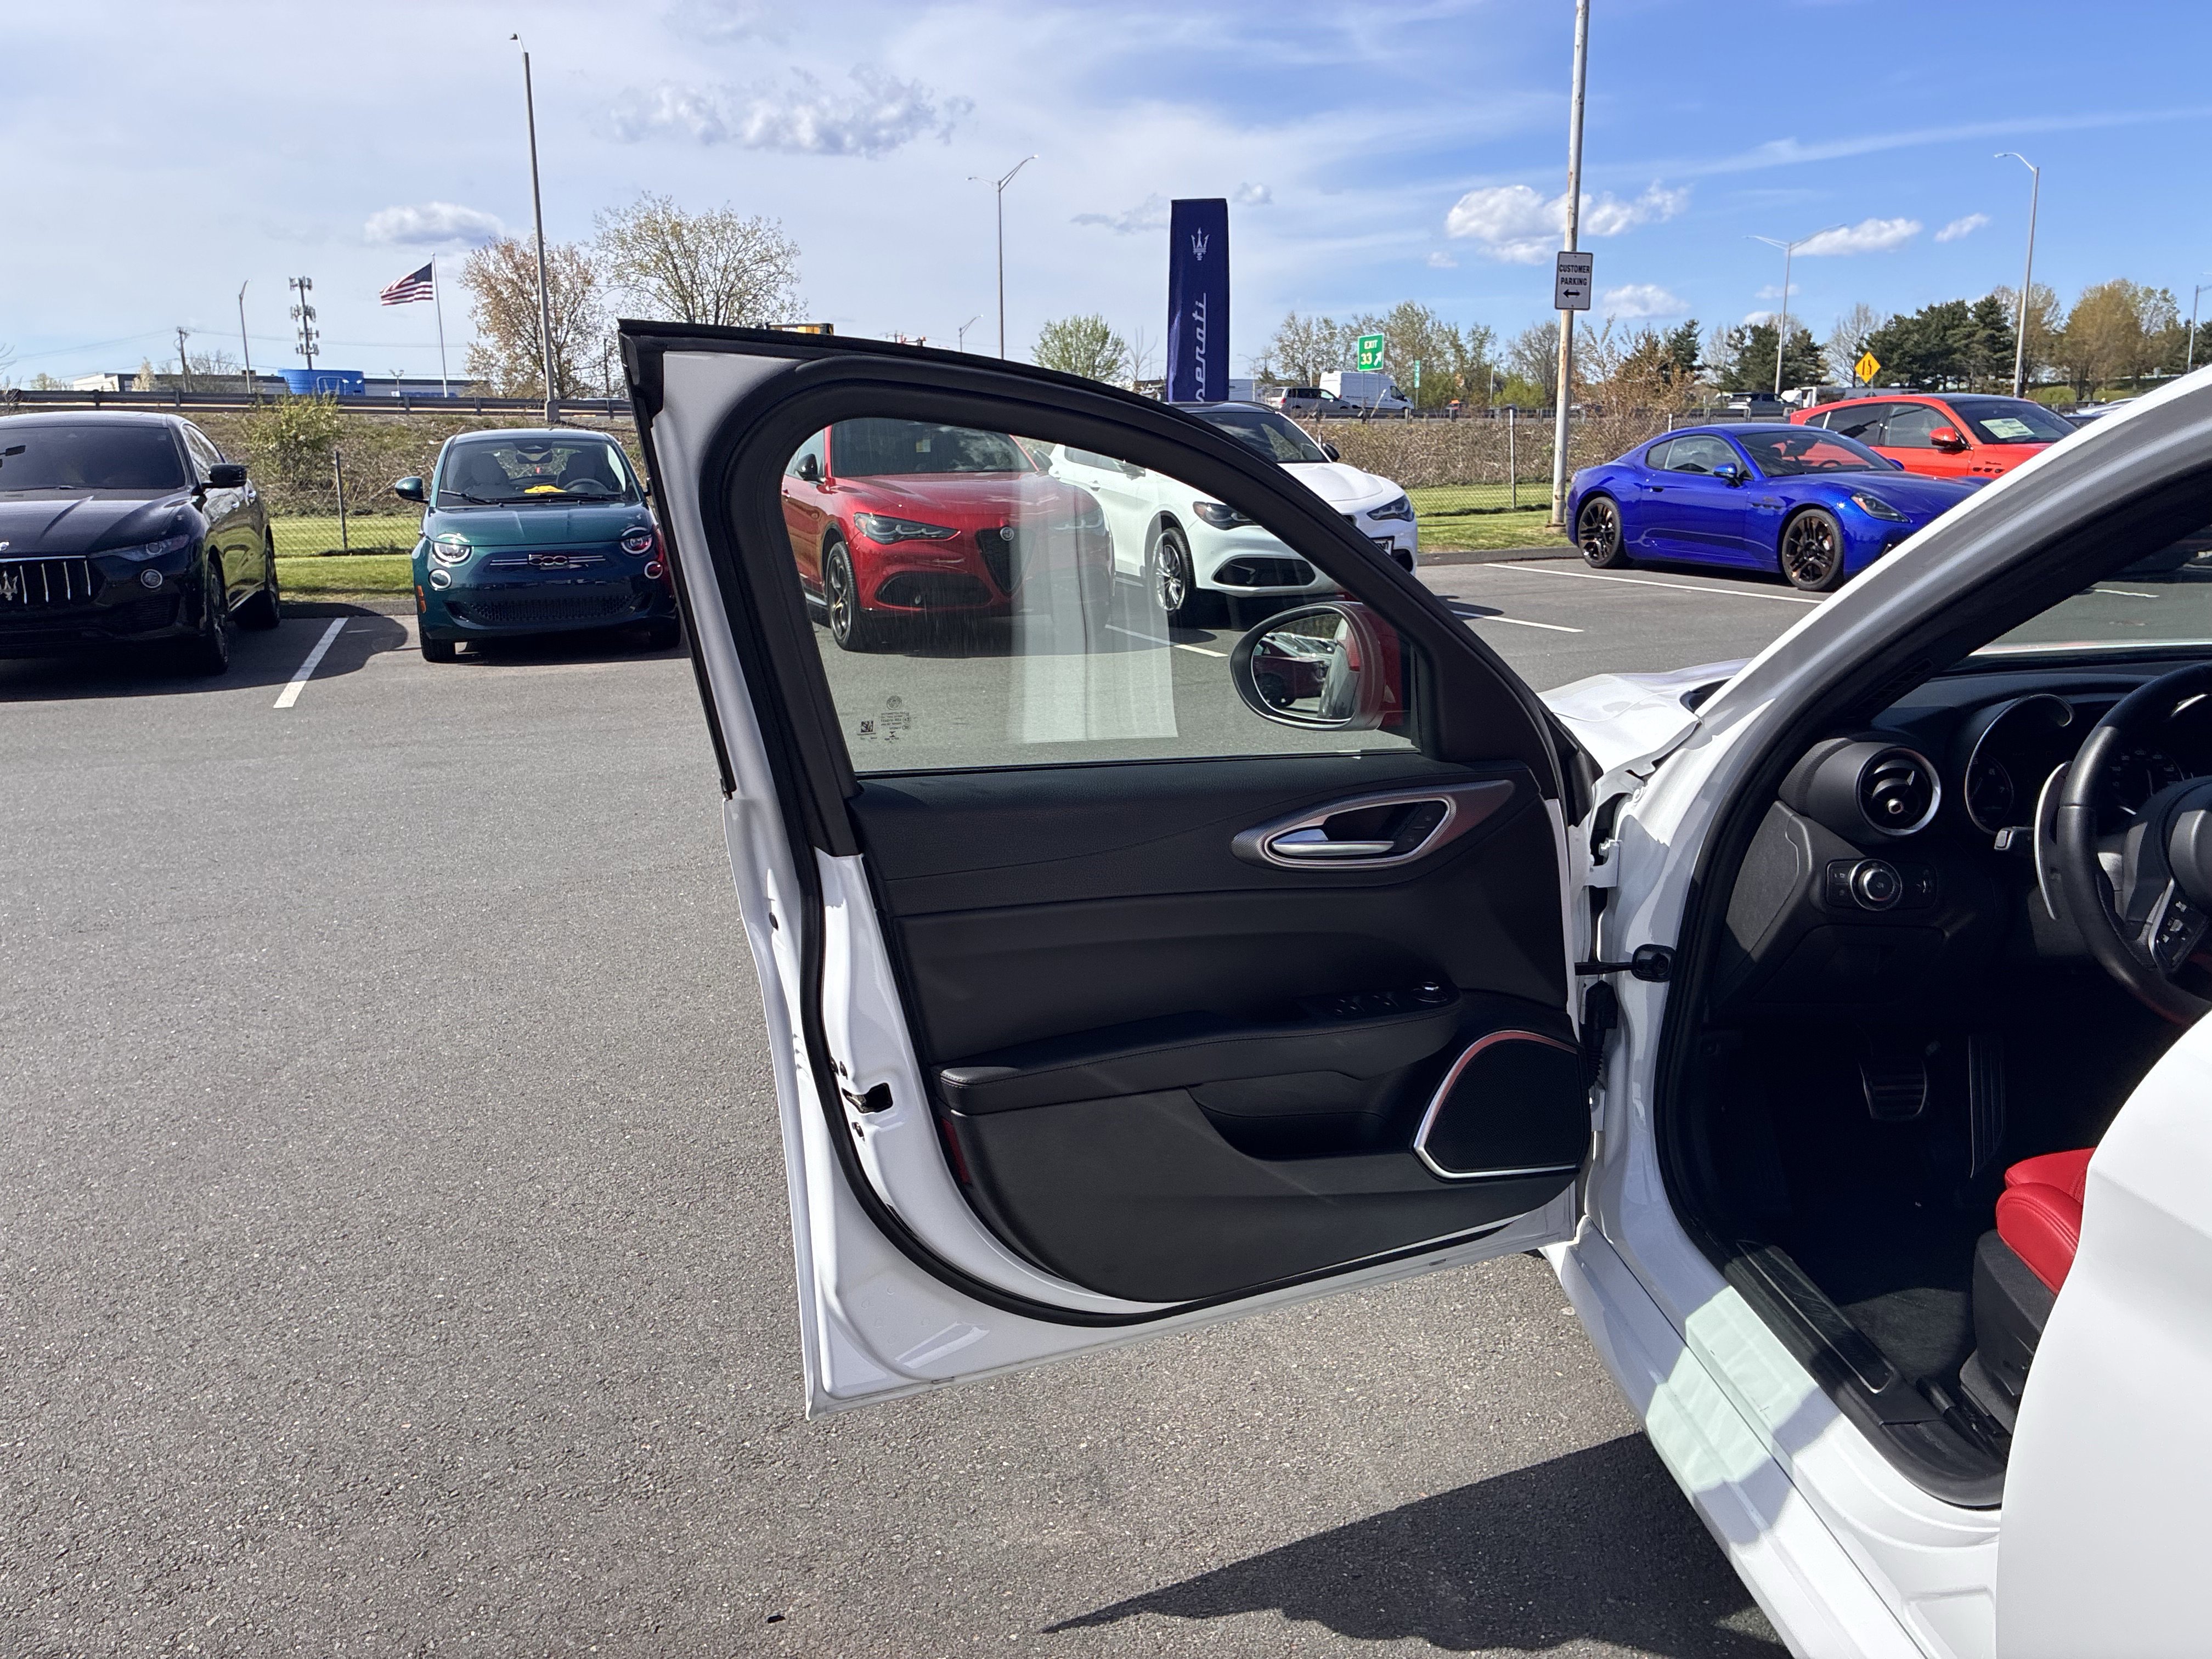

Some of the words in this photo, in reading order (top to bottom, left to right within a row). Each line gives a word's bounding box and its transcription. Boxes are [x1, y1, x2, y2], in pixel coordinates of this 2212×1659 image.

[1559, 264, 1590, 273] CUSTOMER
[1560, 277, 1588, 286] PARKING
[1192, 292, 1206, 404] serati
[1364, 340, 1378, 349] EXIT
[1360, 352, 1372, 365] 33
[528, 554, 568, 566] 500
